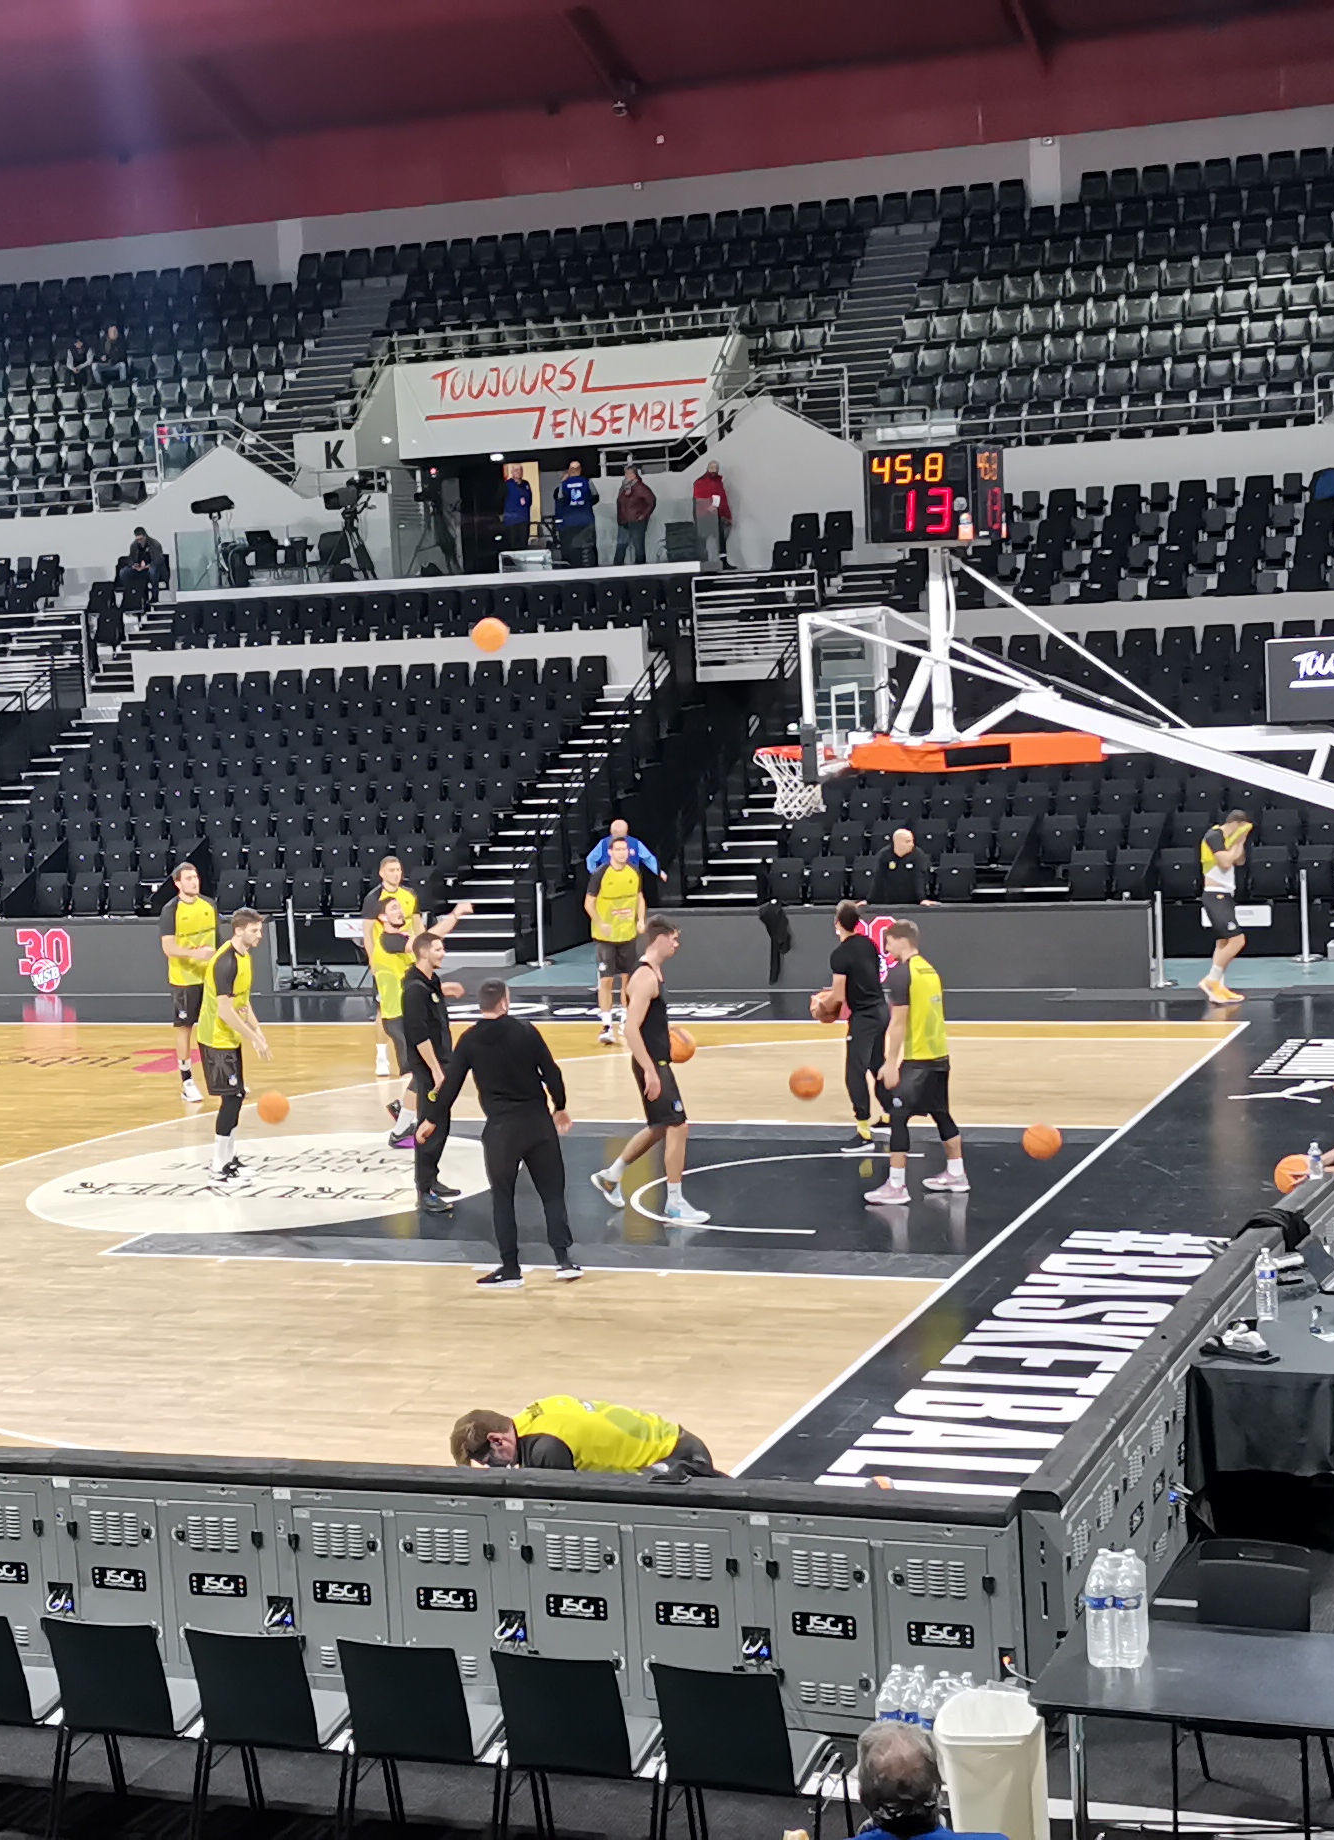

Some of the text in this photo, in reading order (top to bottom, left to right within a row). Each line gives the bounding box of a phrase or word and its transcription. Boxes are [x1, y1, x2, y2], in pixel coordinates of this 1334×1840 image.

[430, 356, 580, 406] TOUJOURS
[550, 398, 700, 438] ENSEMBLE
[325, 439, 344, 469] K
[871, 452, 944, 484] 45.8
[905, 486, 953, 534] 13
[16, 928, 73, 976] 30
[32, 966, 61, 987] MSB
[233, 1154, 415, 1166] FAMILIAL
[63, 1181, 414, 1201] PRUNIER
[103, 1570, 134, 1583] JSG
[201, 1577, 234, 1590] JSG
[325, 1584, 358, 1597] JSG
[429, 1590, 464, 1604] JSG
[559, 1599, 594, 1613] JSG
[669, 1606, 705, 1619] JSG
[805, 1615, 842, 1631] JSG
[921, 1625, 960, 1640] JSG
